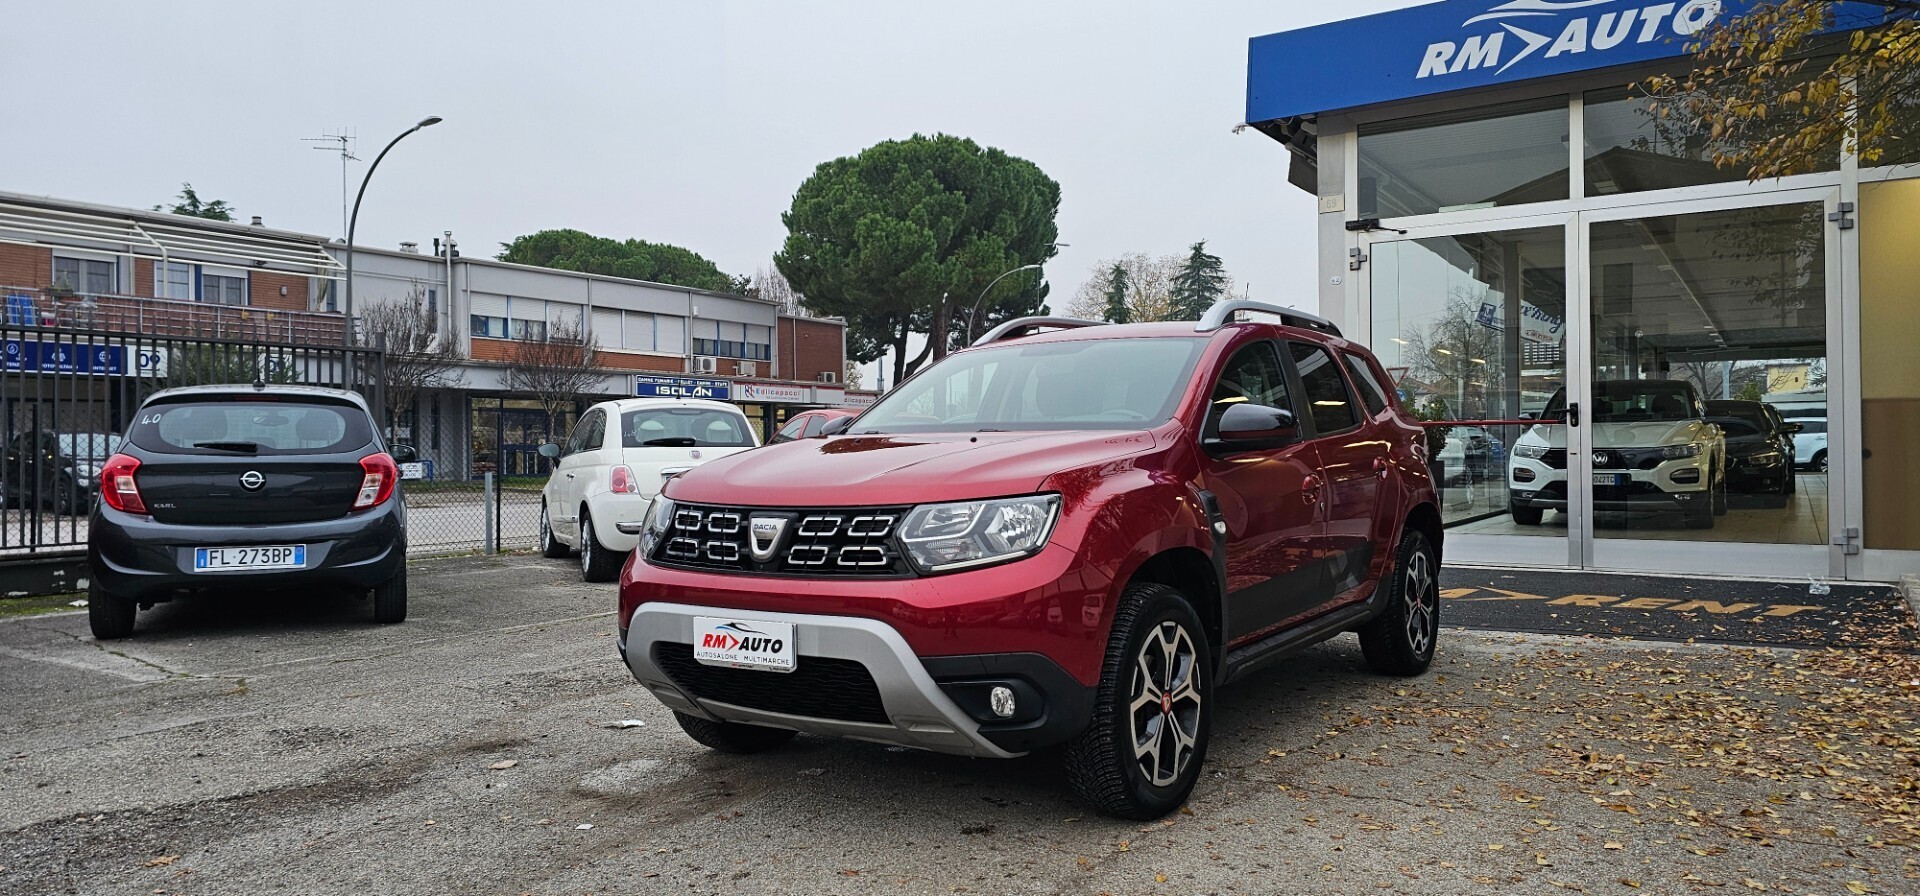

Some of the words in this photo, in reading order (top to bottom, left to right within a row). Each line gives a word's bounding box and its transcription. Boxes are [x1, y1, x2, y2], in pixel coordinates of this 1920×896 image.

[1415, 32, 1505, 79] RM
[1544, 0, 1722, 58] AUTO
[1326, 198, 1337, 208] 69
[656, 386, 712, 398] ISOLAN
[209, 550, 230, 566] FL
[238, 548, 292, 565] 273BP
[1545, 594, 1827, 617] RENT
[703, 633, 728, 649] RM
[739, 636, 783, 653] AUTO
[696, 651, 738, 660] AUTOSALONE
[743, 655, 789, 665] MULTIMARCHE
